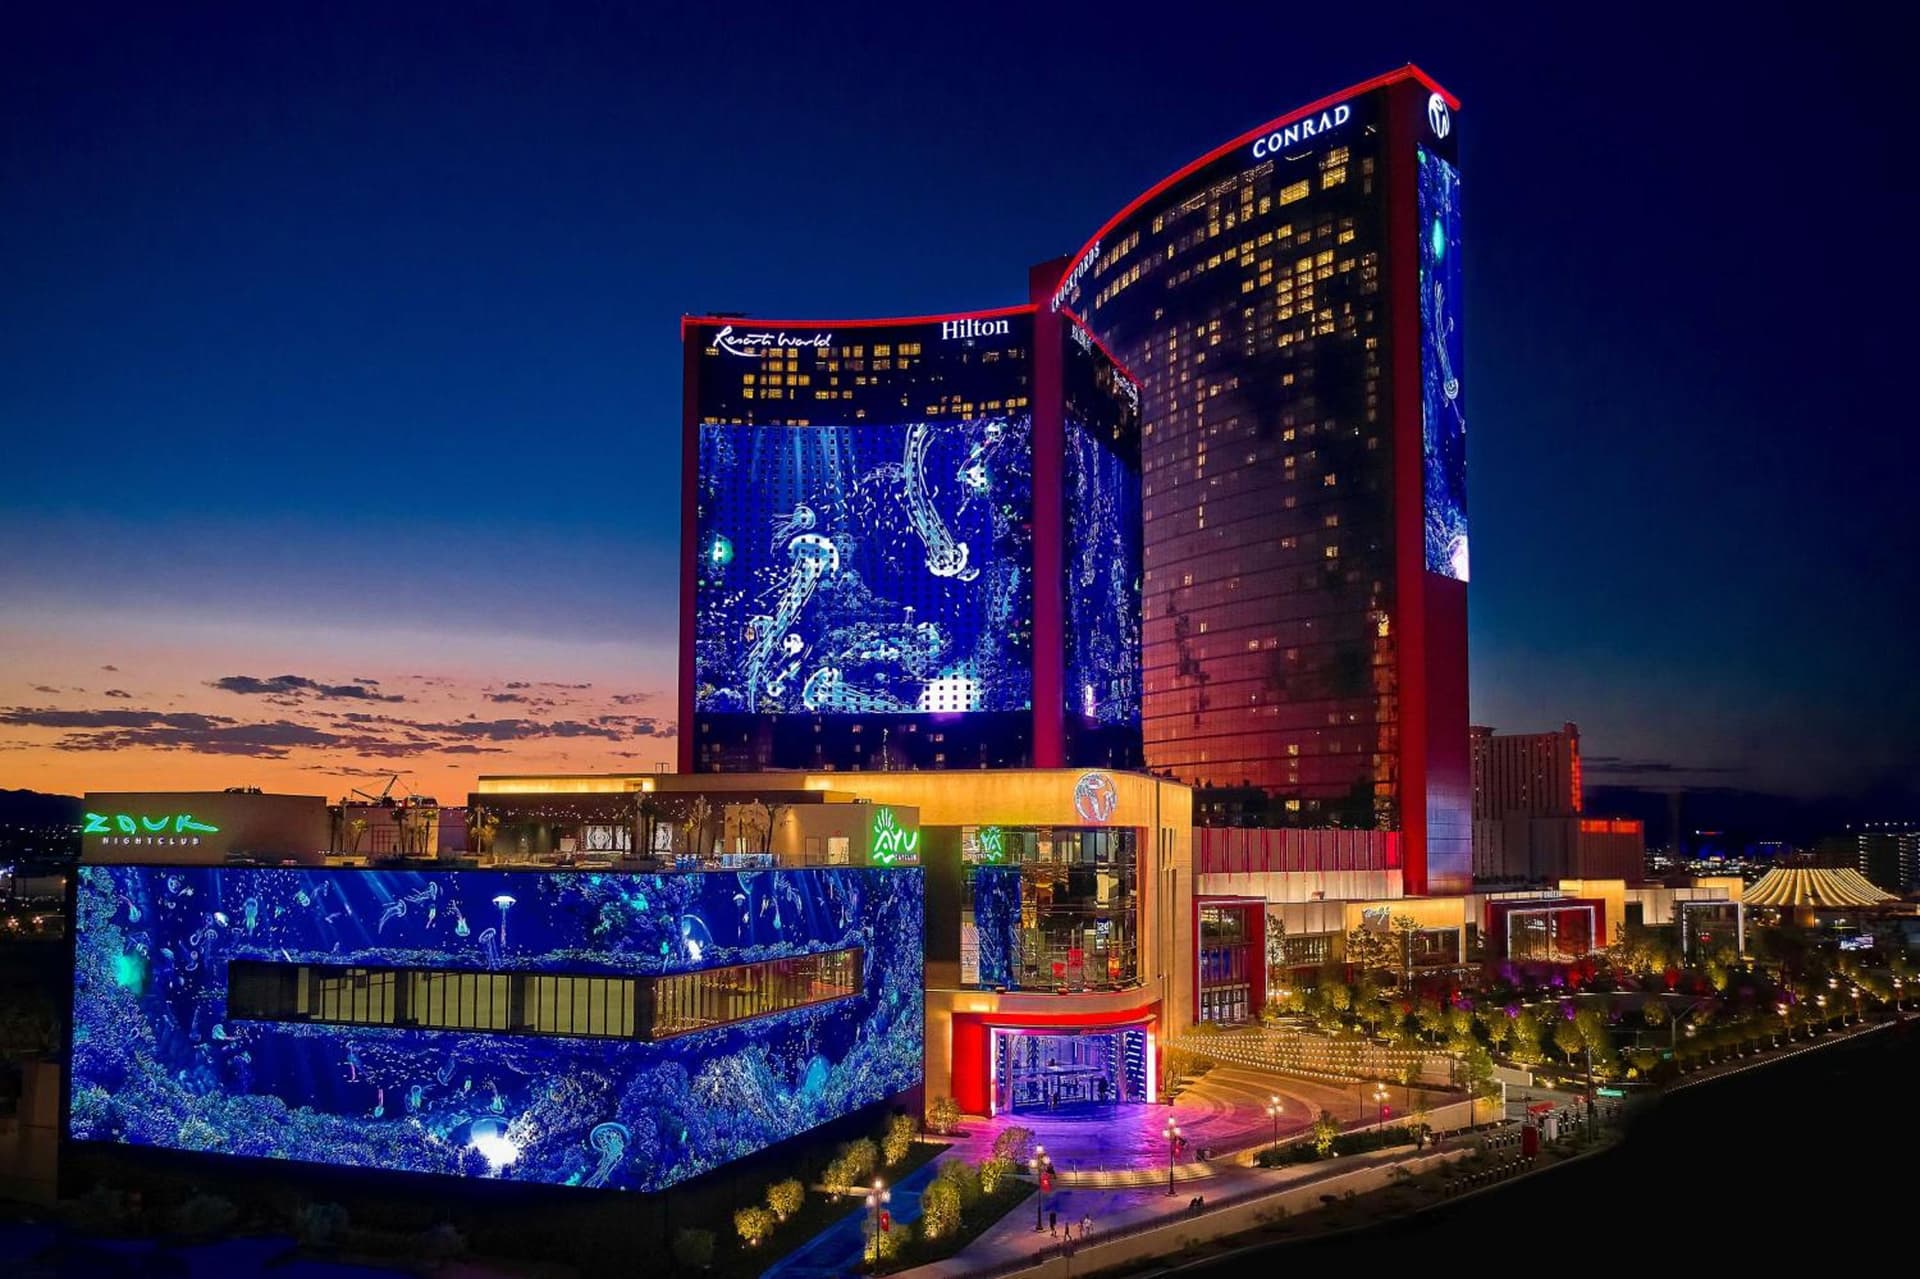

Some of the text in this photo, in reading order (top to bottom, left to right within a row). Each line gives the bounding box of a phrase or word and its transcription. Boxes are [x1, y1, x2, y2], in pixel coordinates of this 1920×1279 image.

[1252, 104, 1350, 159] CONRAD
[712, 325, 832, 357] Resorts World
[941, 318, 1009, 340] Hilton
[102, 836, 201, 846] NIGHTCLUB
